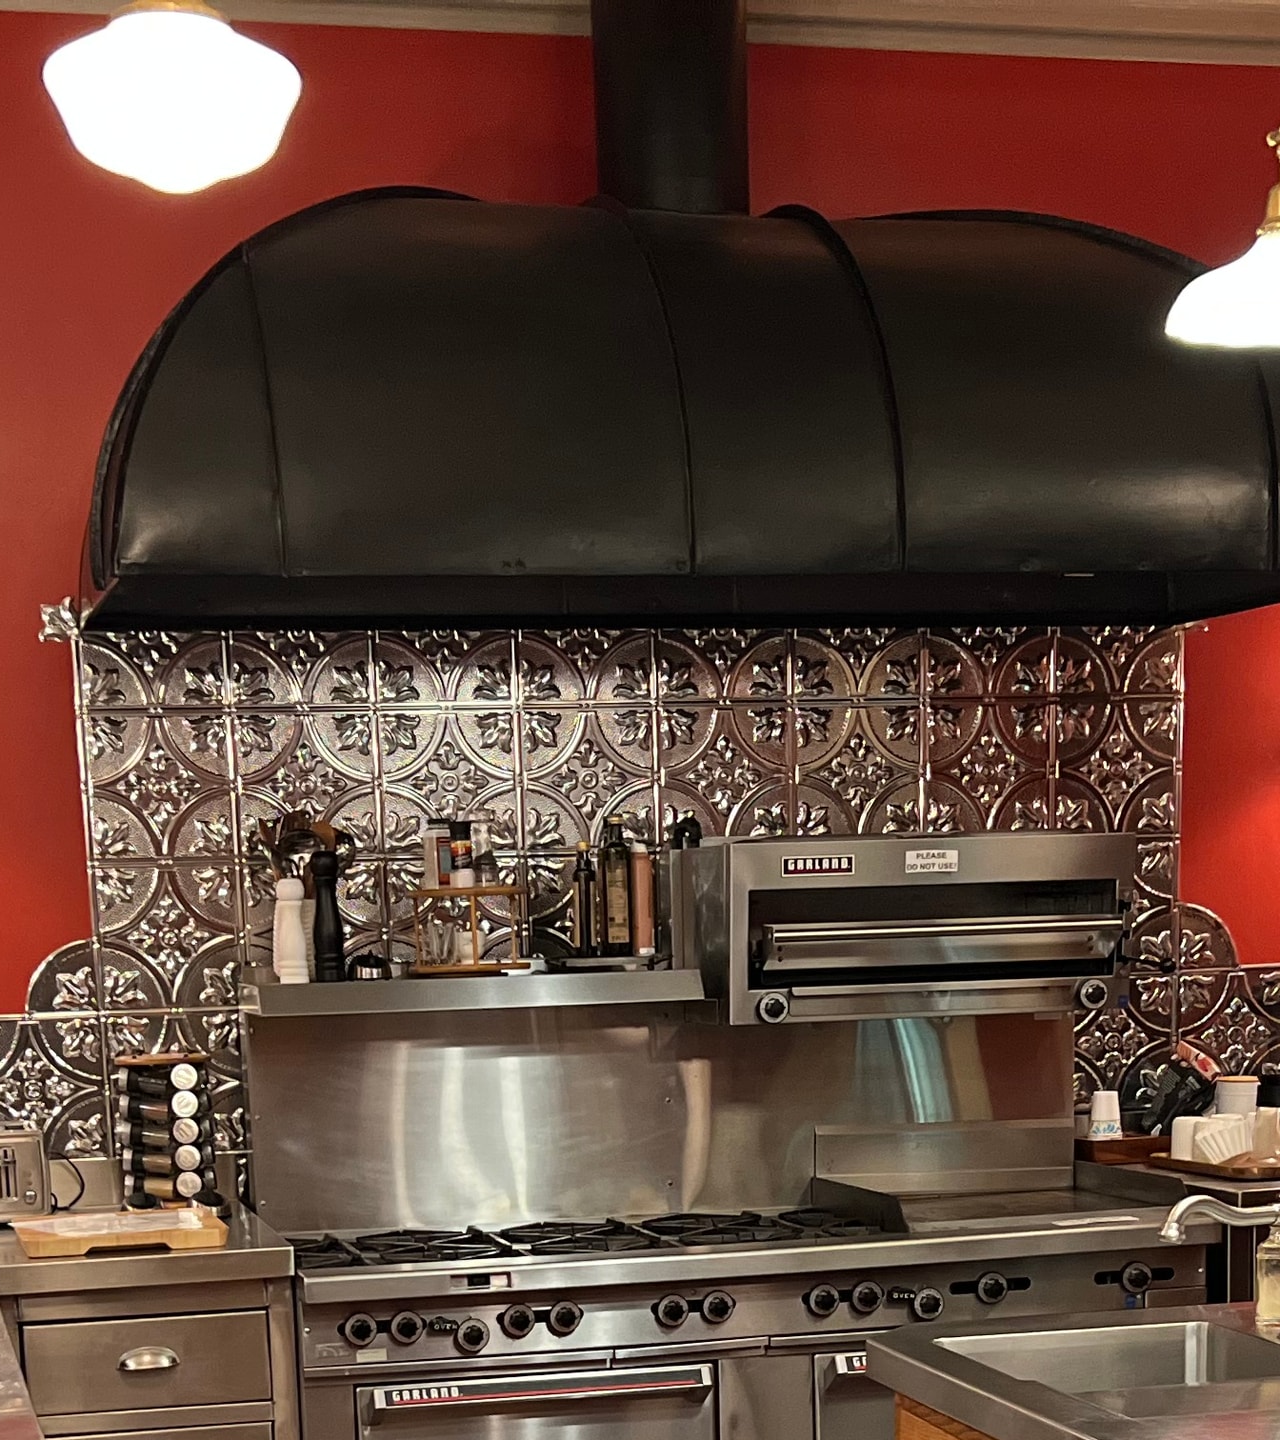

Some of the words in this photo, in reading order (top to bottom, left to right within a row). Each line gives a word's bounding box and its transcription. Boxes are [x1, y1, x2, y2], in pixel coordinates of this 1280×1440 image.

[916, 851, 947, 860] PLEASE
[787, 857, 849, 871] GARLAND
[906, 863, 919, 871] DO
[919, 862, 937, 870] NOT
[392, 1386, 461, 1402] GARLAND
